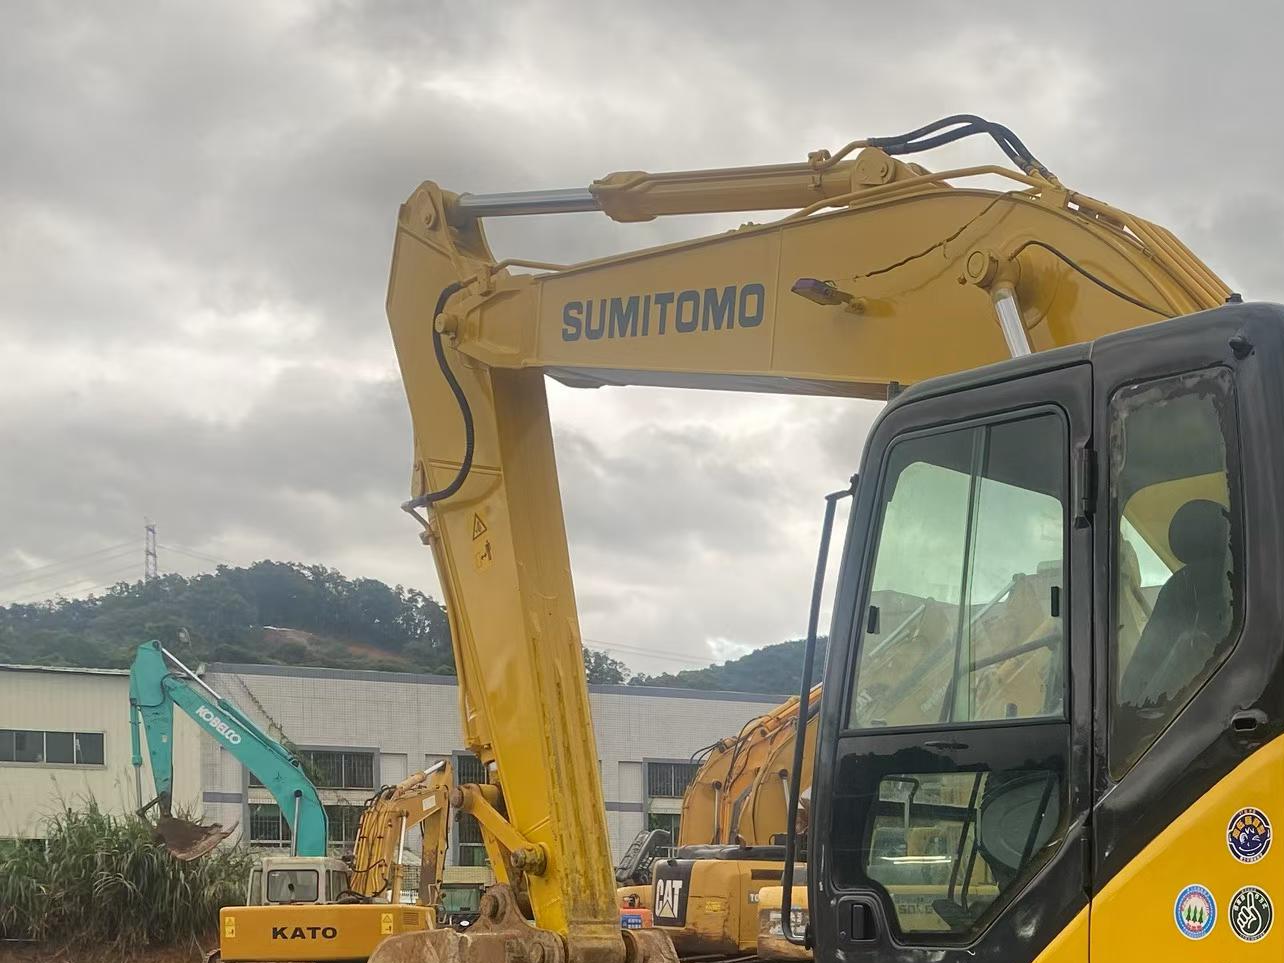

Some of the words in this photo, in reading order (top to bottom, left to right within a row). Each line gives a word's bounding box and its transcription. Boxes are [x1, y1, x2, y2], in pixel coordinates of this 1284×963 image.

[562, 283, 765, 342] SUMITOMO
[195, 705, 241, 744] KOBELCO
[655, 879, 683, 918] CAT
[272, 927, 337, 939] KATO
